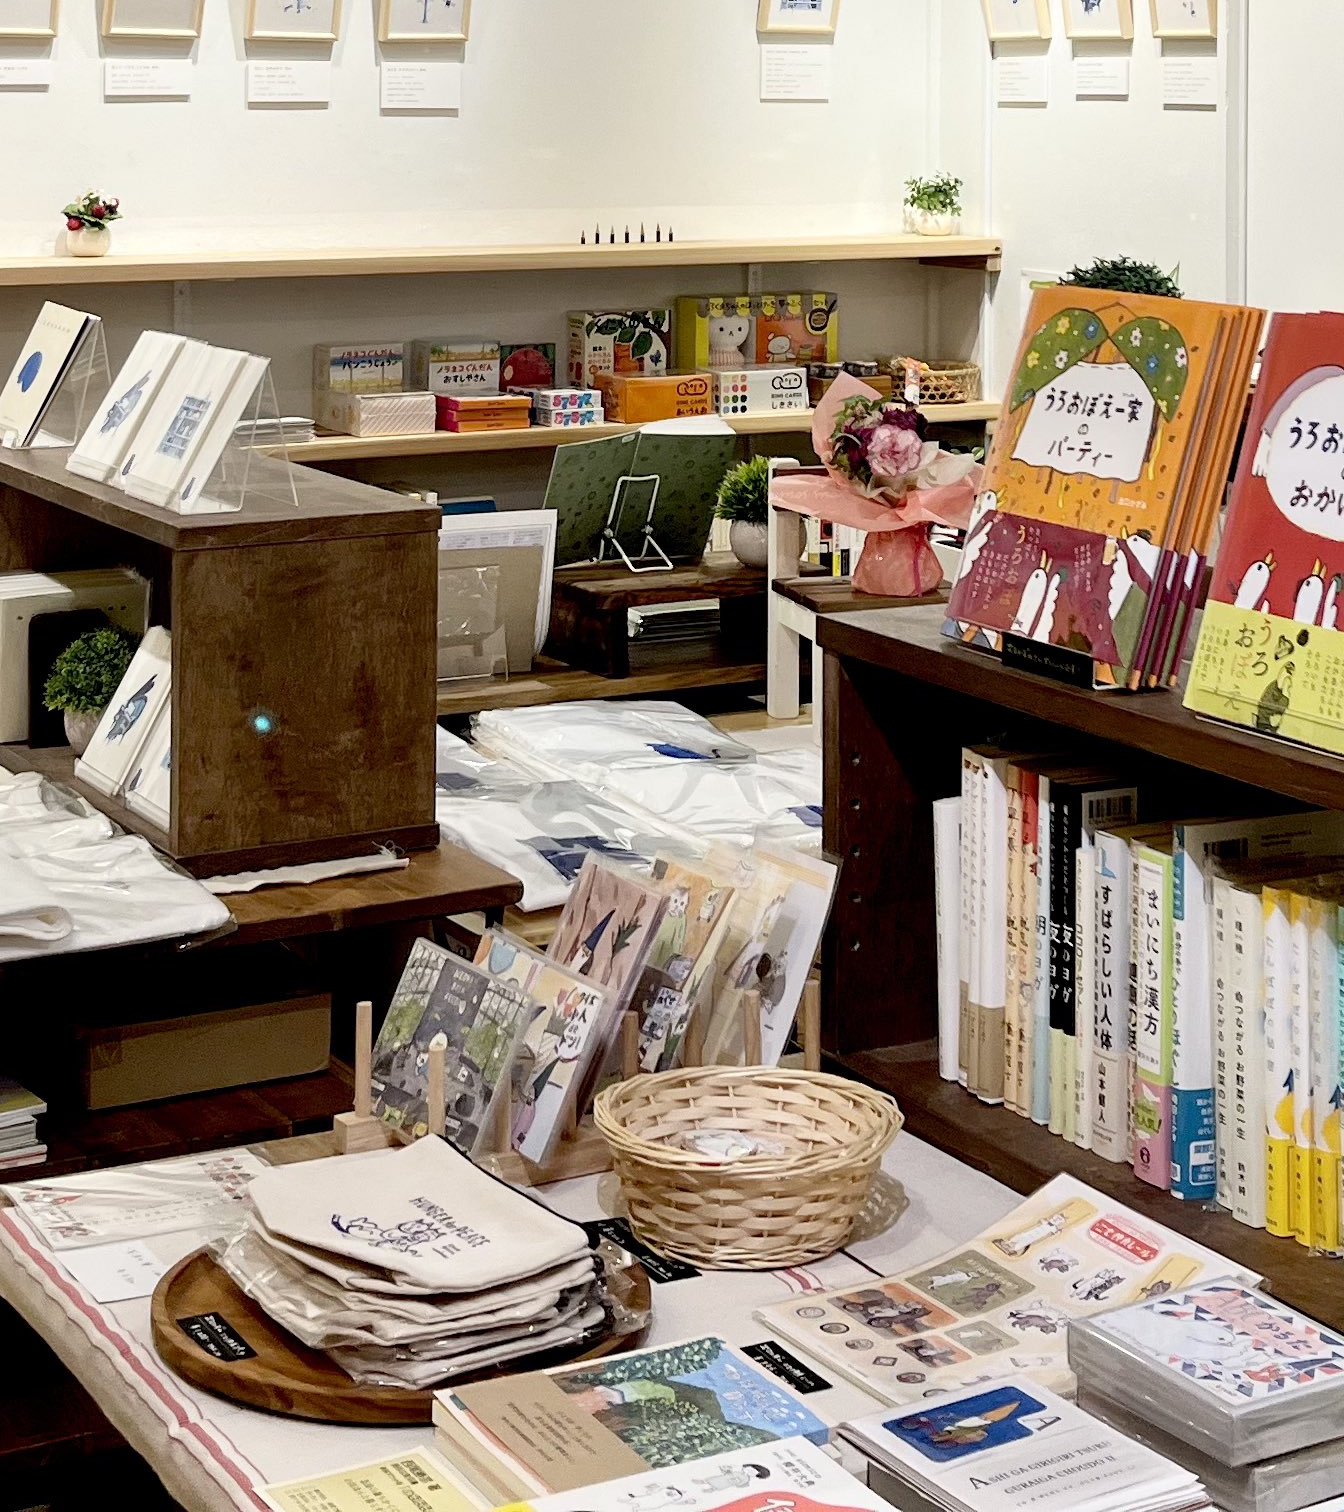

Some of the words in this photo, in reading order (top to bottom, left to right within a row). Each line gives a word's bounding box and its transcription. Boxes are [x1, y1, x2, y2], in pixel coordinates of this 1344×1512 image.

[1045, 387, 1143, 423] うろおぼえ一家
[1077, 424, 1089, 436] の
[1047, 436, 1113, 468] パーティー
[1063, 923, 1074, 1003] 夜のヨガ
[1100, 885, 1113, 1050] すばらしい人体
[1144, 888, 1159, 1035] まいにち漢方
[1098, 1062, 1107, 1123] 山本健人
